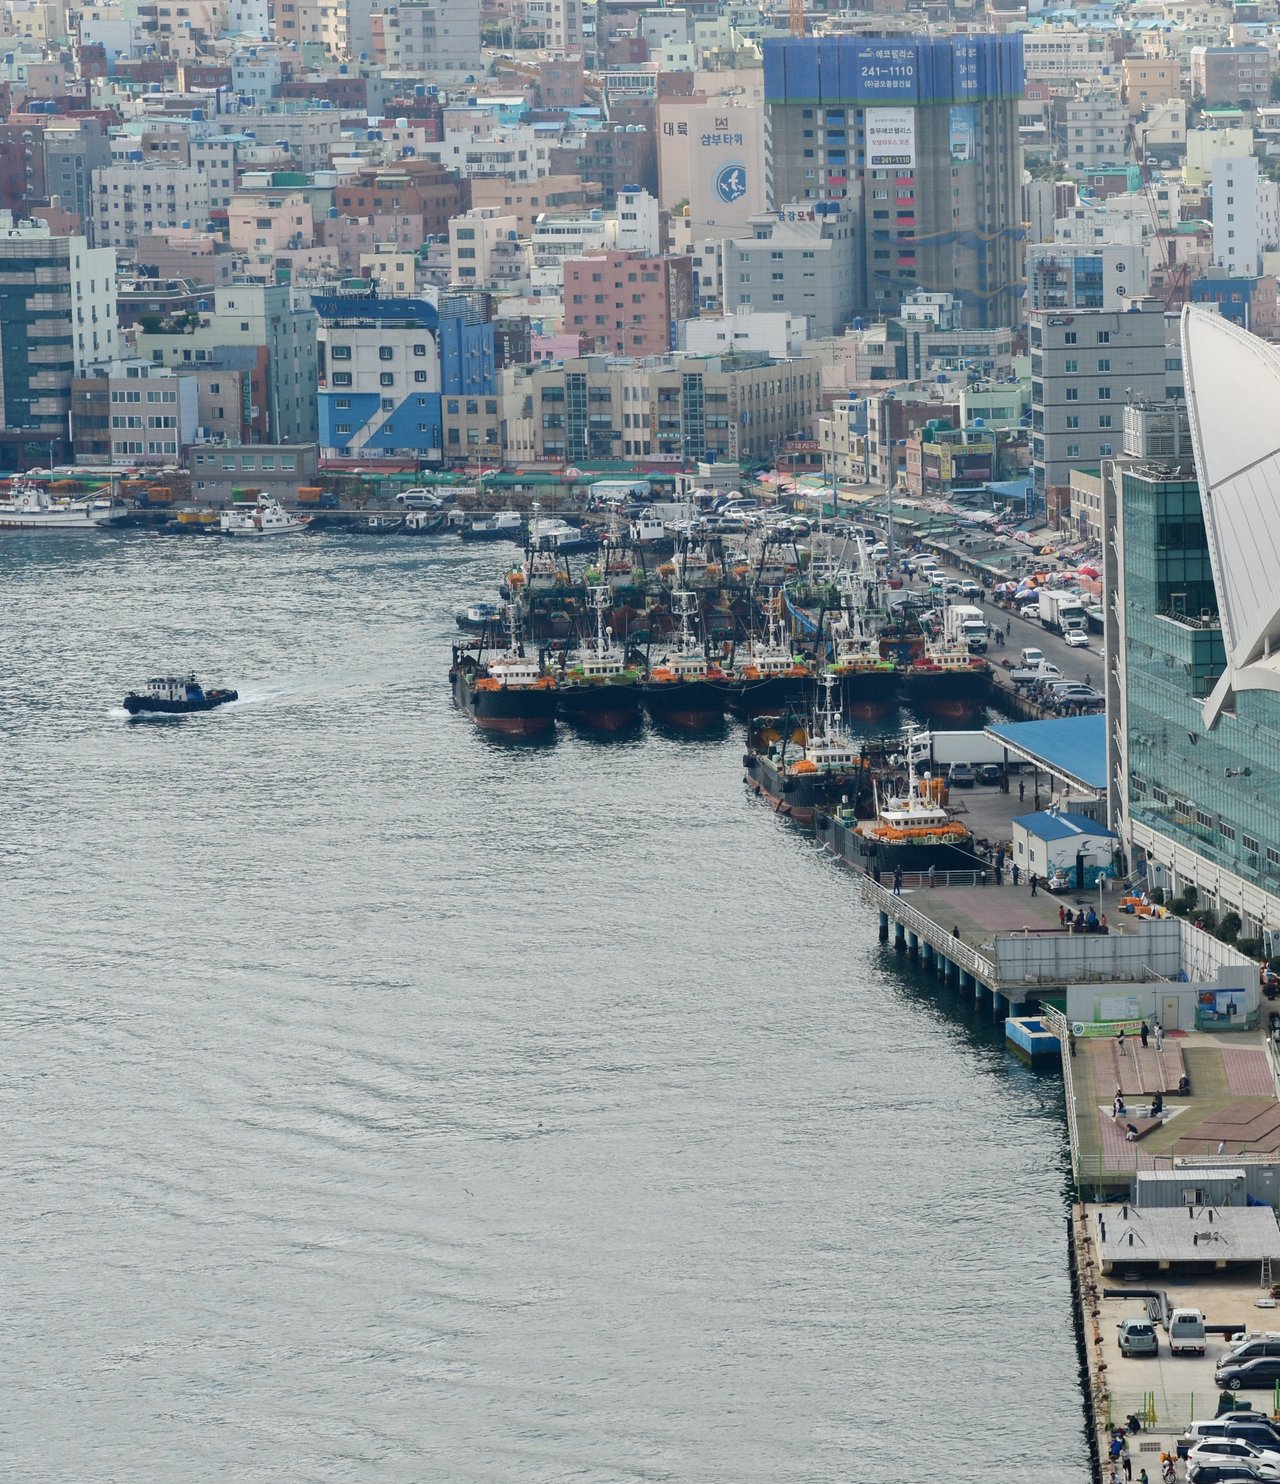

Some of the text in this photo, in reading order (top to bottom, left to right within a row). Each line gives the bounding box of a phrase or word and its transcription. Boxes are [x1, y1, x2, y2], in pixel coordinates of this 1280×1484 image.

[861, 65, 913, 76] 241-1110
[663, 122, 688, 136] 대륙
[881, 156, 910, 164] 241-1110
